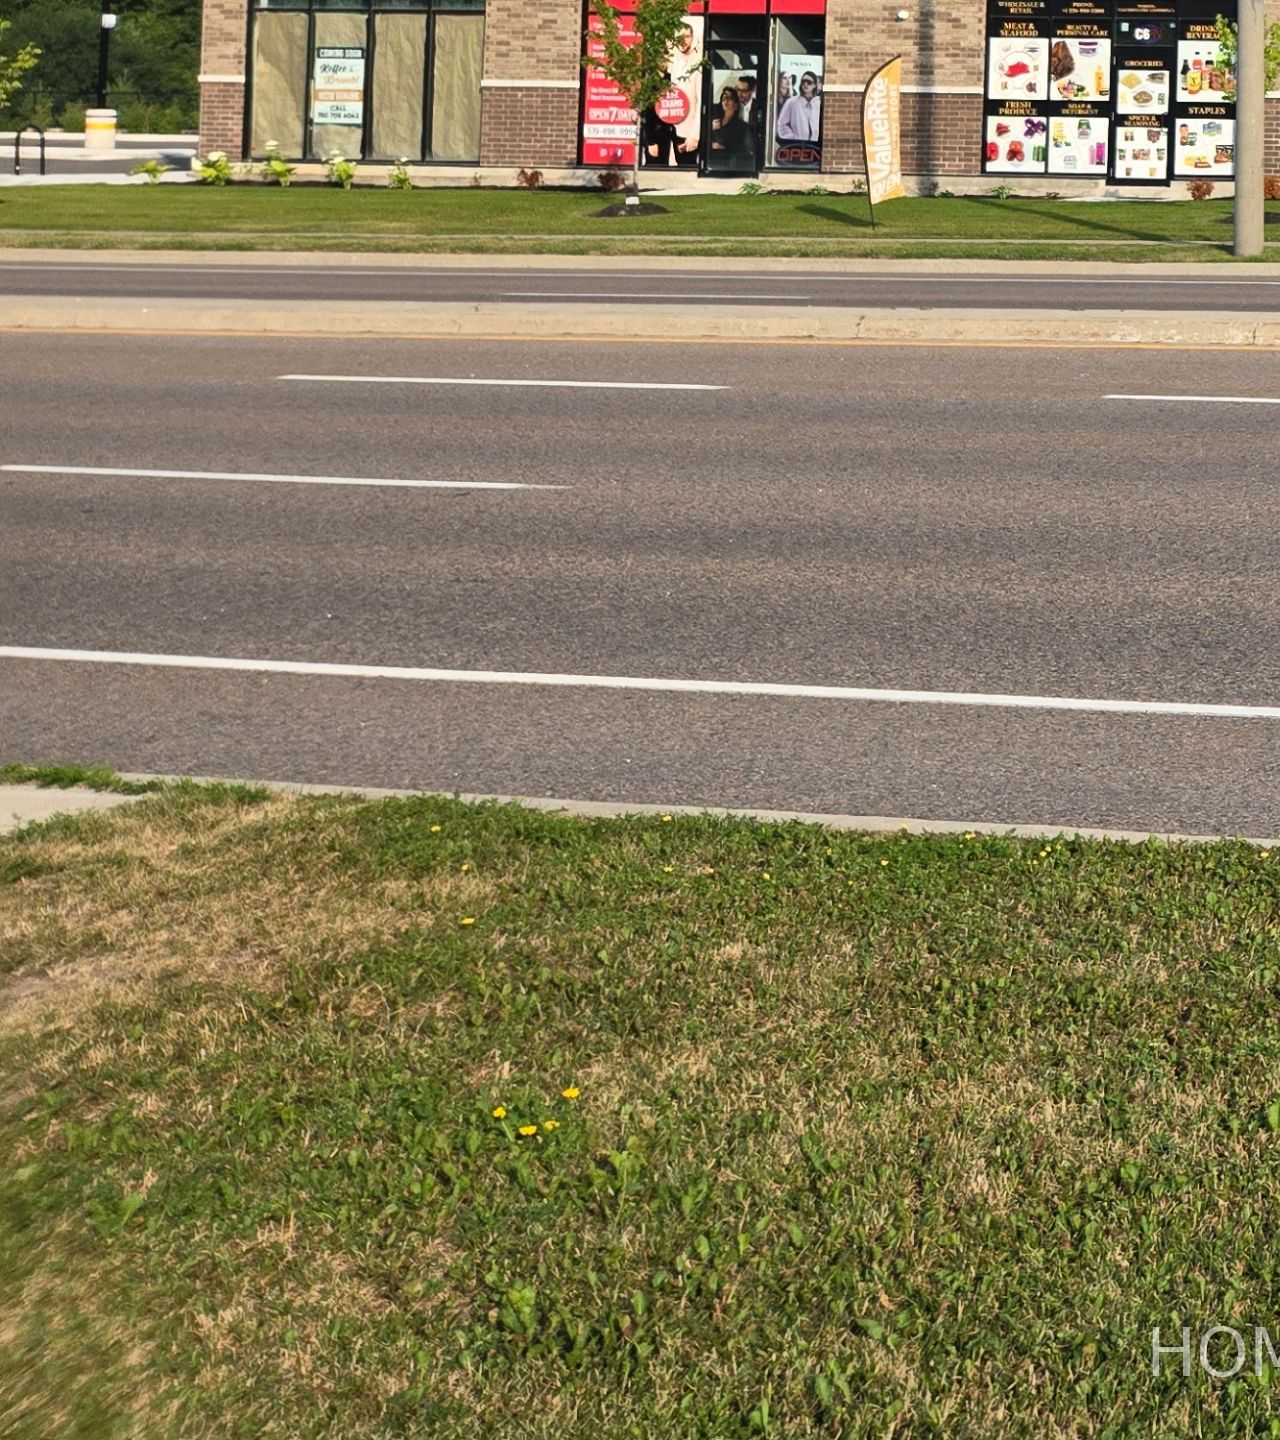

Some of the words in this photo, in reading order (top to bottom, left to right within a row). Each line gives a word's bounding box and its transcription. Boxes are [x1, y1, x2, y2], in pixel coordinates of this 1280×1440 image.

[1003, 22, 1027, 30] MEAT
[1028, 22, 1035, 30] &
[1134, 27, 1150, 40] C6
[609, 106, 618, 122] 7
[1188, 107, 1226, 115] STAPLES
[867, 75, 894, 182] ValueRite
[777, 149, 822, 162] OPEN
